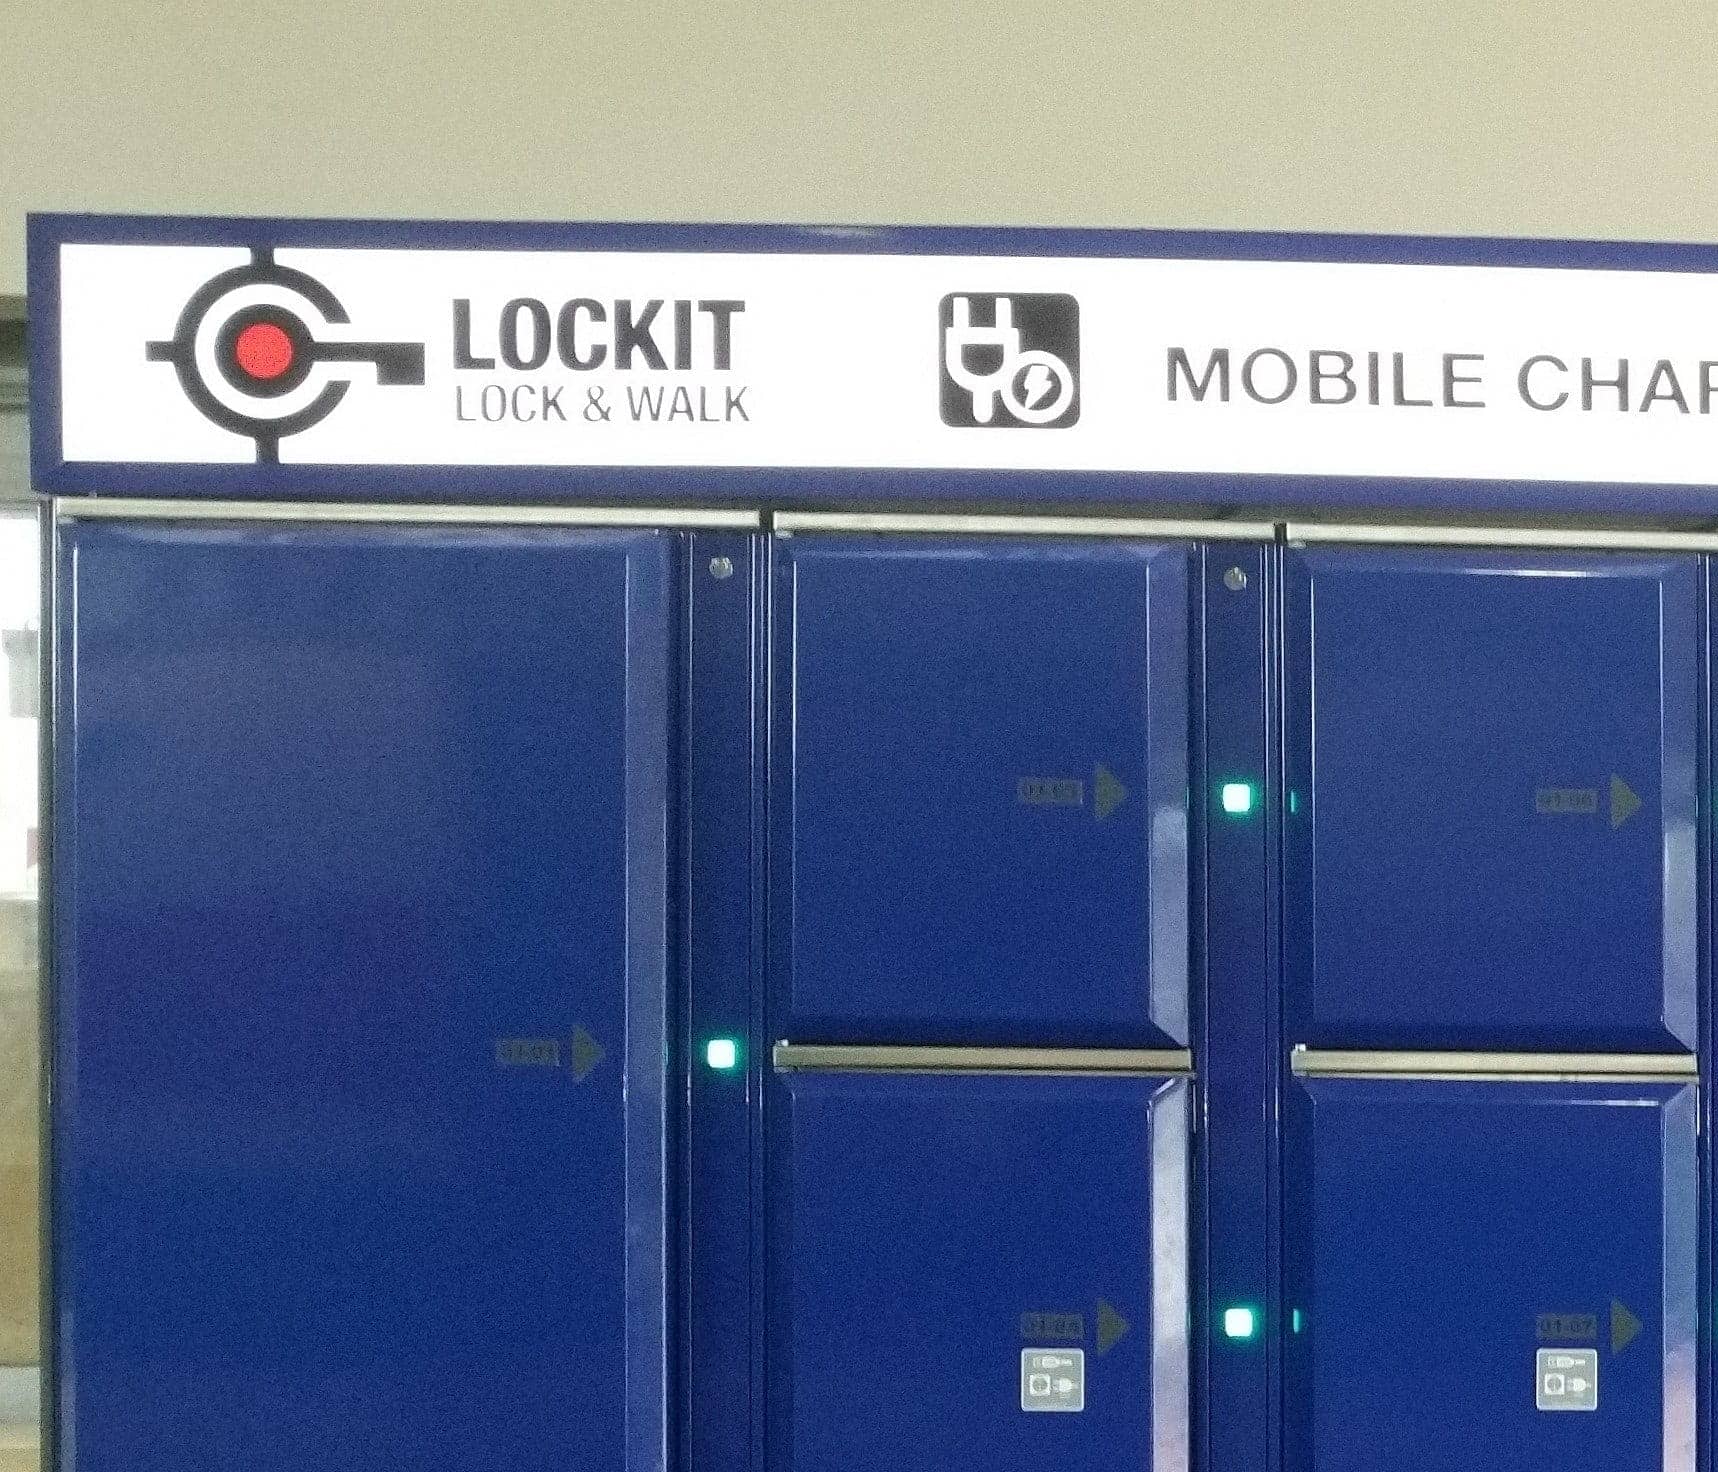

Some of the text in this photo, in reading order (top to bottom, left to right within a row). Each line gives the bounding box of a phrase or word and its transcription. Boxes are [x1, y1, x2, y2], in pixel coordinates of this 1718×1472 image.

[453, 297, 746, 371] LOCKIT
[456, 384, 750, 423] LOCK & WALK
[1166, 346, 1486, 408] MOBILE
